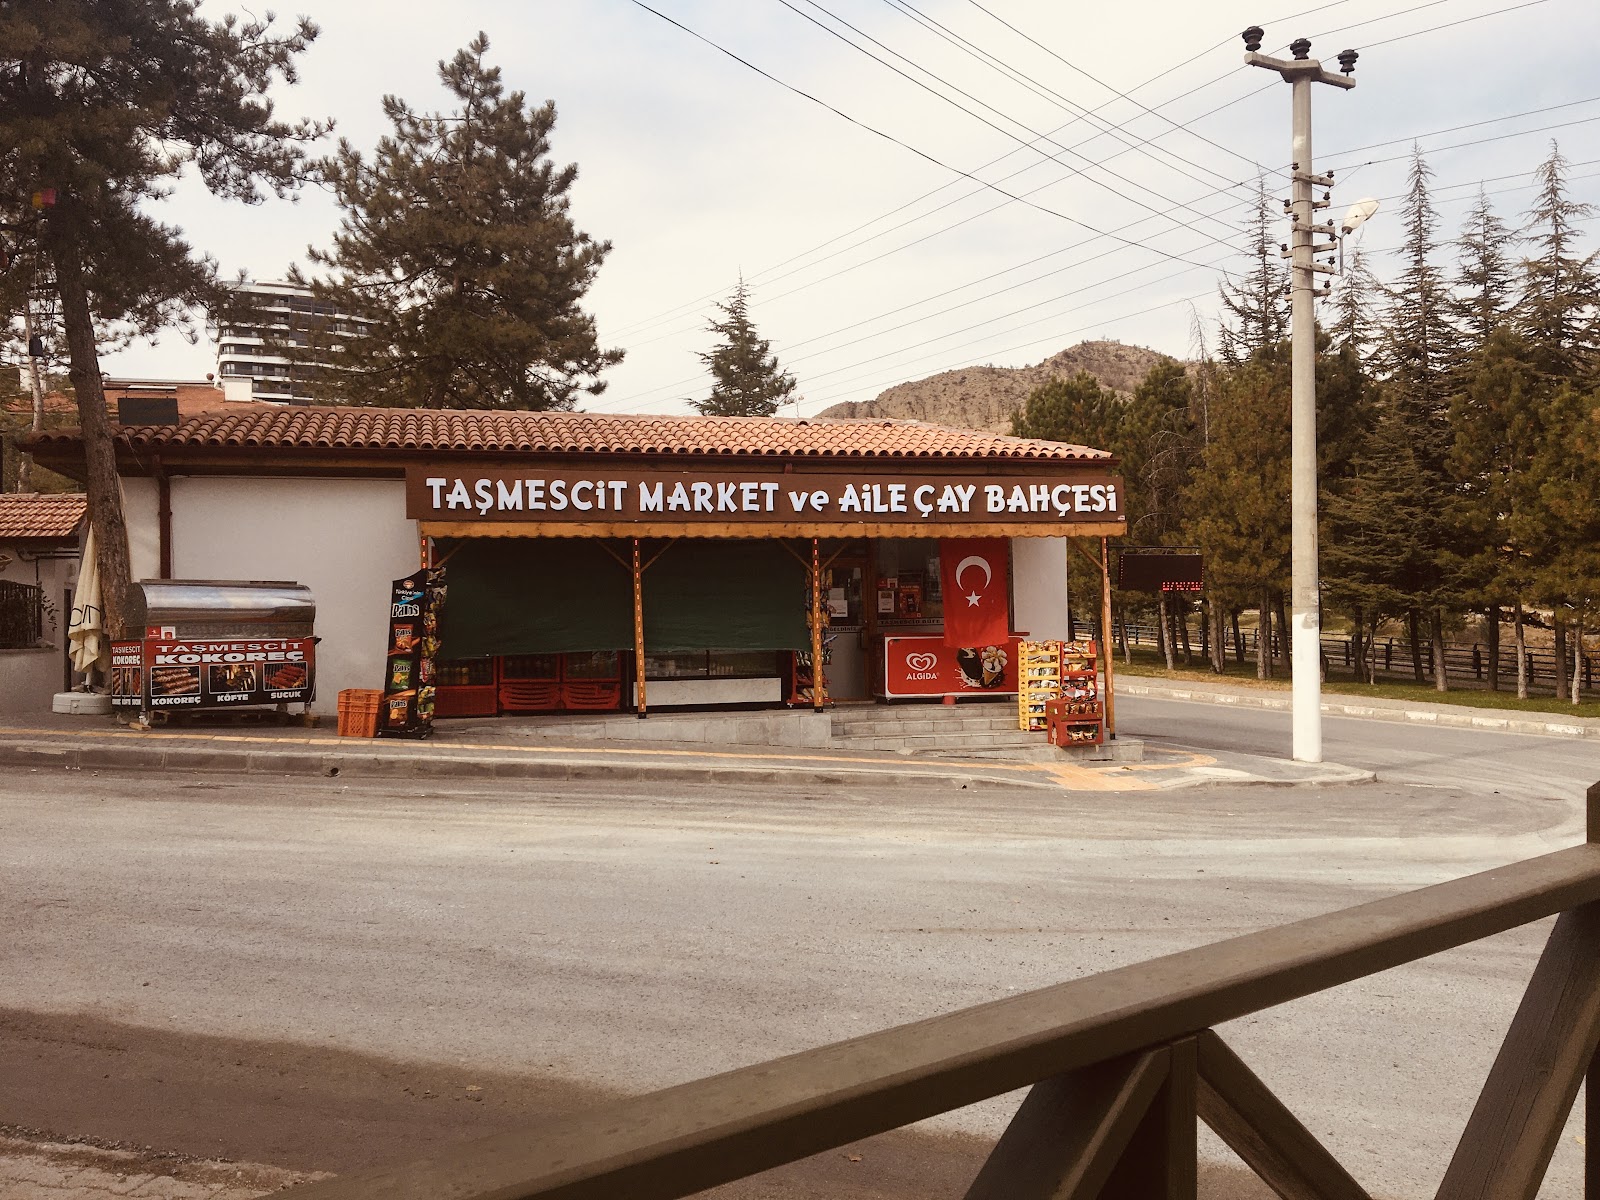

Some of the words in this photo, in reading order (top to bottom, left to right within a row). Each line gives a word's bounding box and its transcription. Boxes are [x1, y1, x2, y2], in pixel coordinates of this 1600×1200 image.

[638, 481, 779, 513] MARKET
[788, 490, 830, 512] ve
[913, 484, 976, 518] ÇAY
[155, 651, 304, 665] KOKOREÇ
[151, 696, 201, 706] KOKOREÇ
[217, 693, 249, 702] KÖFTE
[270, 690, 302, 699] SUCUK
